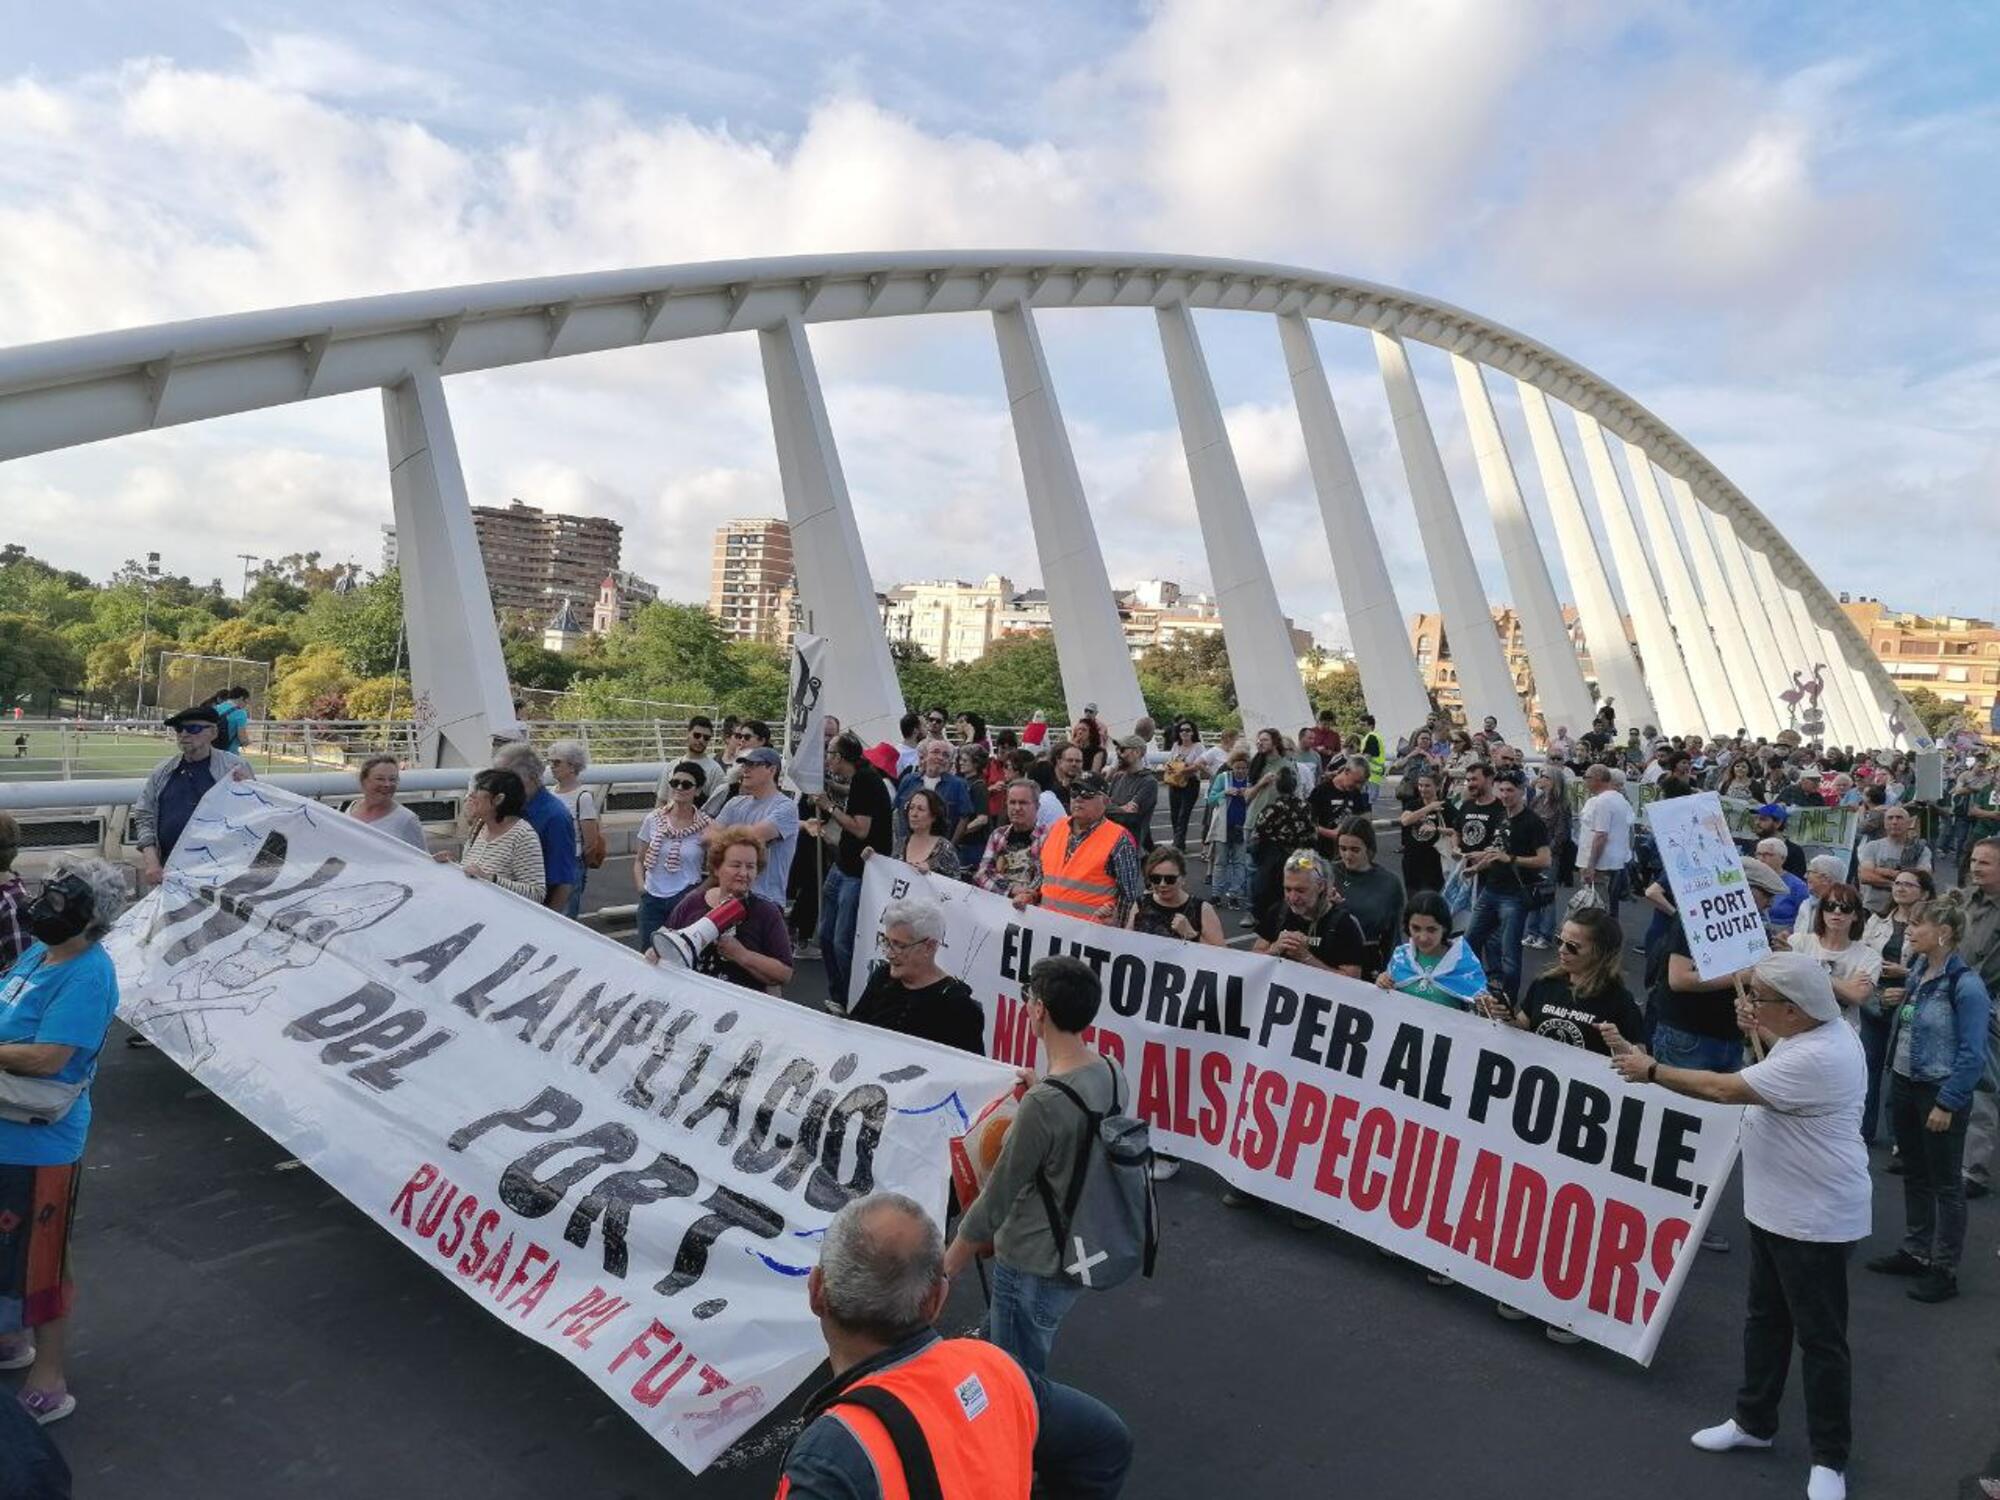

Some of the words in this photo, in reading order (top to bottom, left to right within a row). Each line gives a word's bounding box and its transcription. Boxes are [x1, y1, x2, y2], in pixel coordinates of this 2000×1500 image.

[384, 921, 486, 984] A
[1700, 888, 1748, 920] PORT
[1705, 912, 1759, 943] CIUTAT
[1000, 923, 1034, 984] EL
[1258, 982, 1375, 1079] PER
[1379, 1021, 1453, 1110] AL
[1468, 1048, 1709, 1211] POBLE,
[1137, 1040, 1232, 1147] ALS
[389, 1162, 561, 1320] RUSSAFA
[447, 1086, 785, 1321] PORT.
